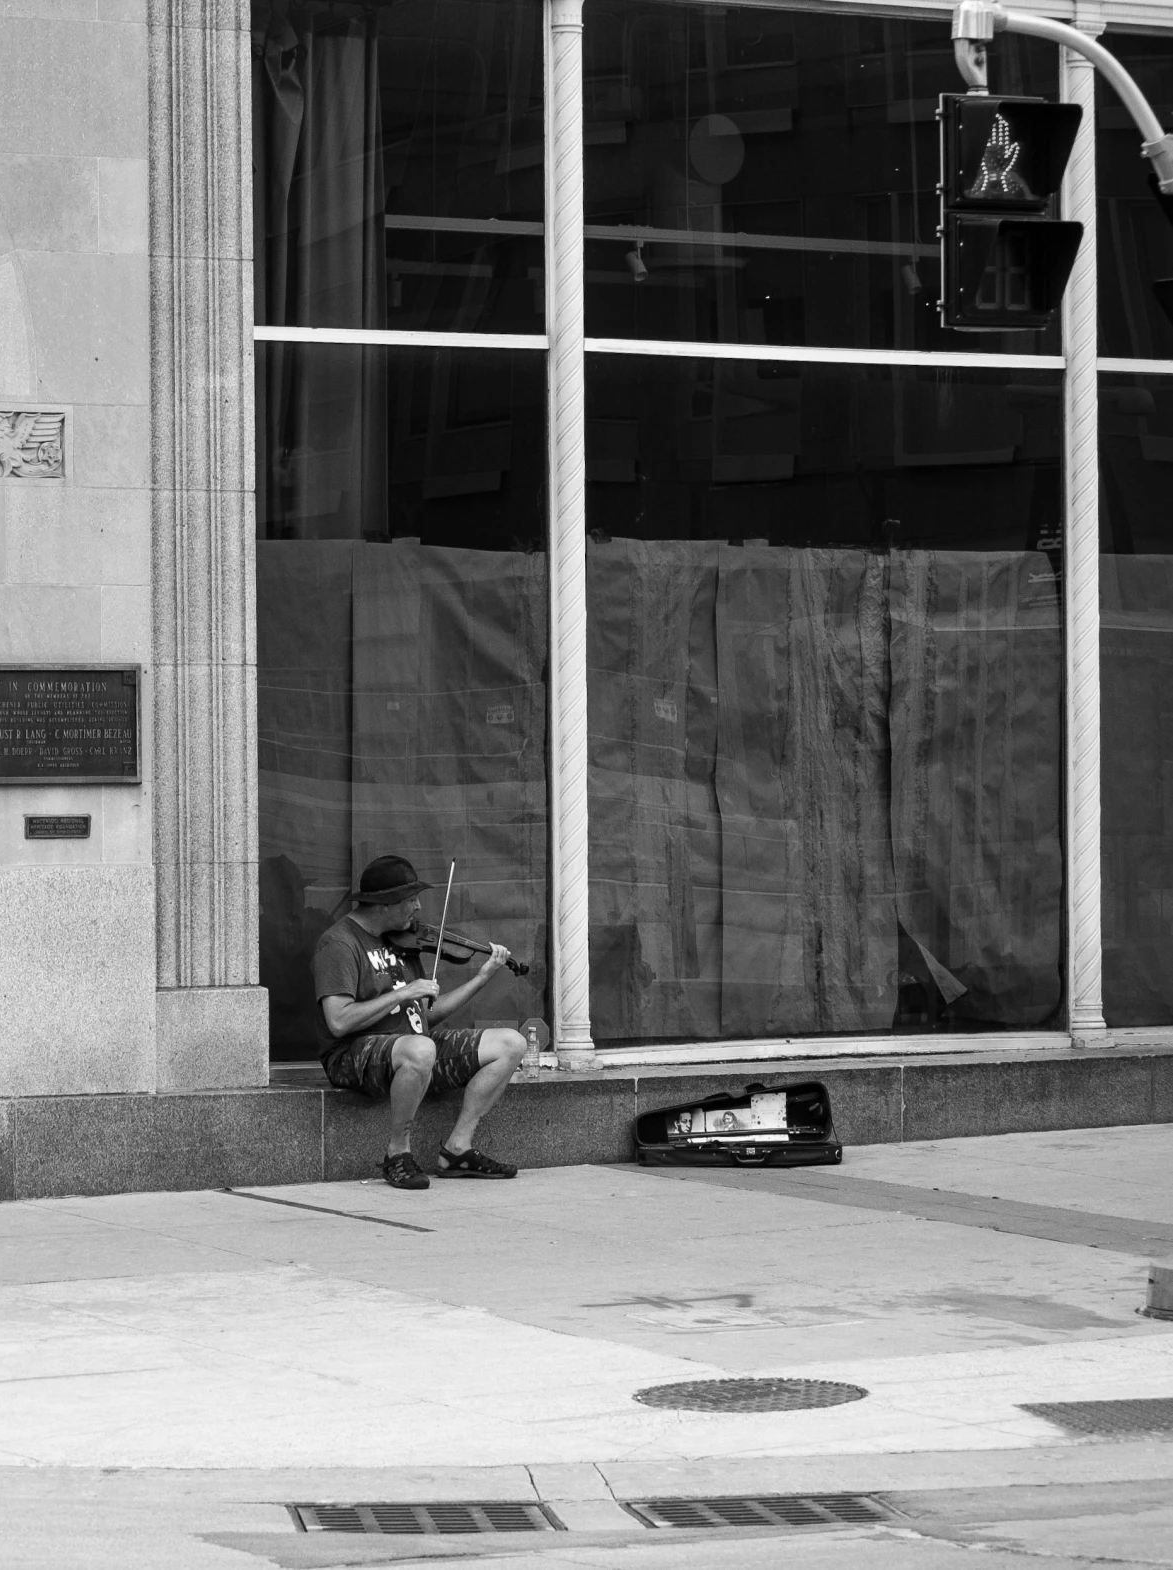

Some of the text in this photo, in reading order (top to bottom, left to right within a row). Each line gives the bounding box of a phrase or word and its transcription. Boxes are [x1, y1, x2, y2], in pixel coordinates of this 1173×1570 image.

[9, 682, 108, 692] IN COMMEMORATION
[25, 729, 47, 740] LANG
[62, 729, 101, 739] MORTIMER
[104, 728, 132, 739] BEZEAU
[12, 747, 33, 756] DOERR
[39, 747, 59, 756] DAVID
[63, 747, 83, 756] GROSS
[89, 747, 106, 755] CARL
